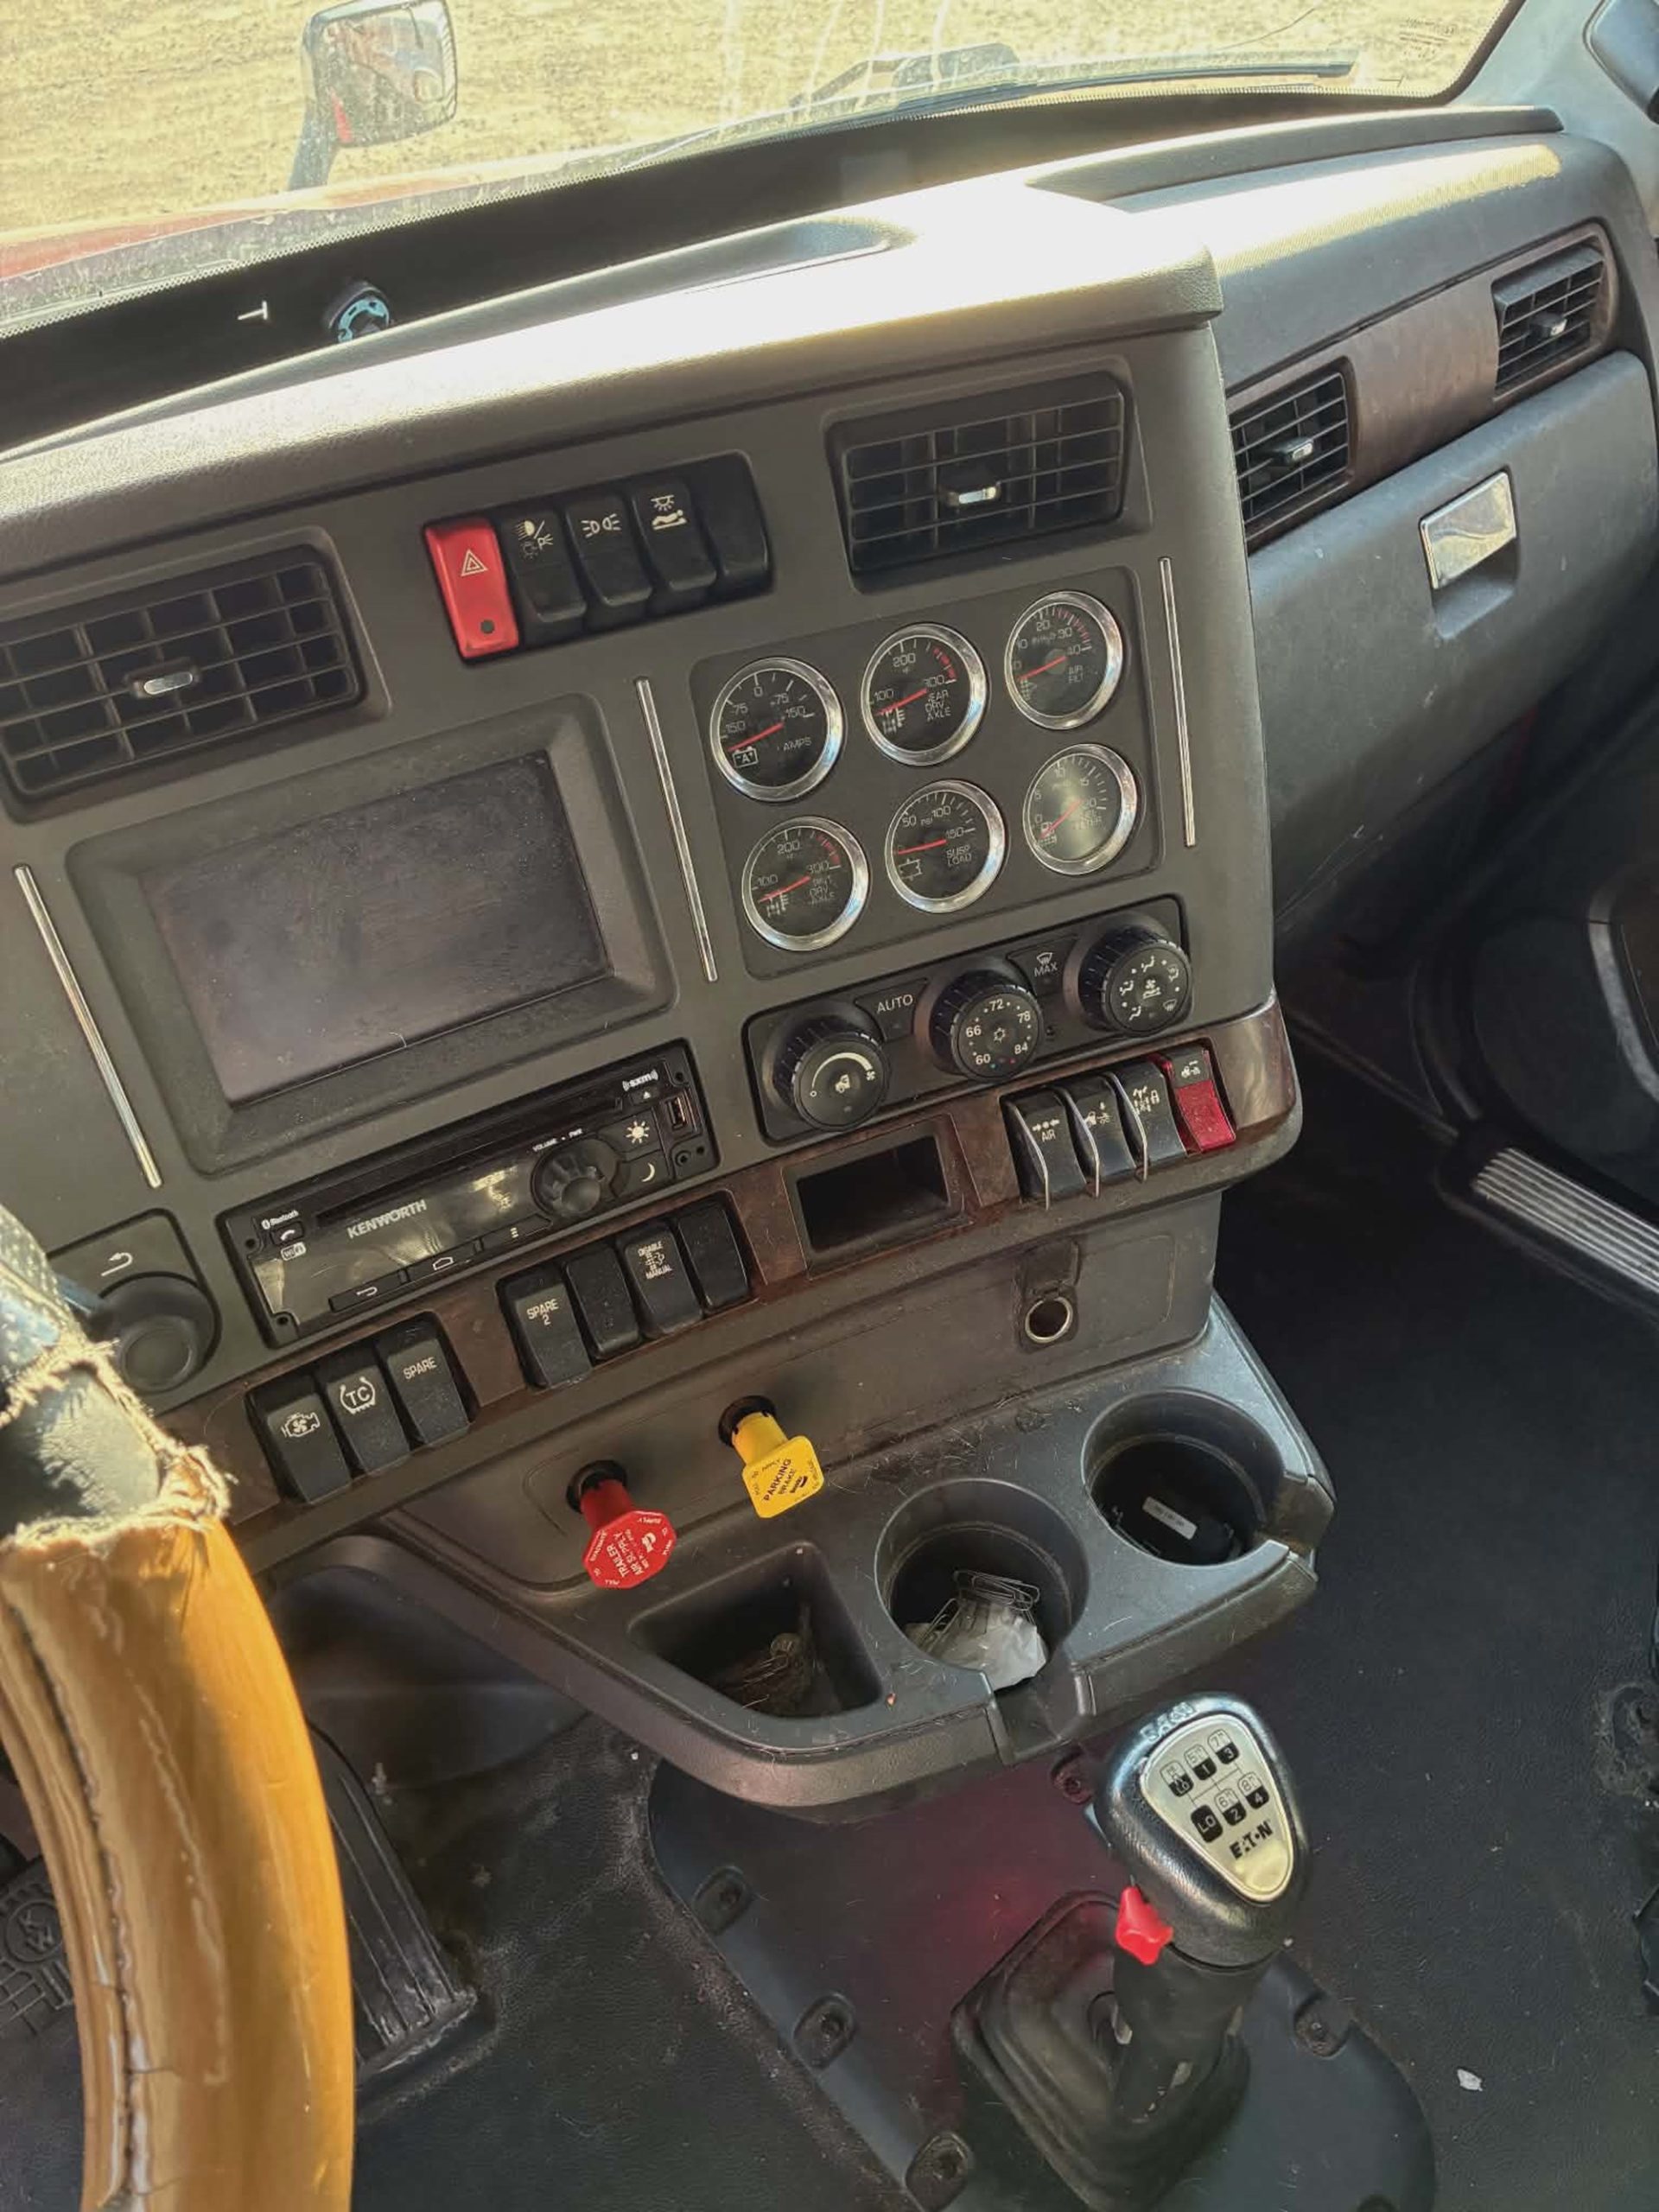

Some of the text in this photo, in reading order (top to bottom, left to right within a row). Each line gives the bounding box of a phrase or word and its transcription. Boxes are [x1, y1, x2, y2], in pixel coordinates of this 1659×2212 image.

[1037, 620, 1051, 632] 20
[1058, 627, 1072, 639] 30
[893, 652, 916, 667] 200
[753, 686, 763, 697] 0
[874, 688, 894, 701] 100
[927, 707, 951, 721] AXLE
[783, 737, 812, 751] AMPS
[931, 805, 951, 818] 100
[902, 816, 917, 827] 50
[945, 827, 964, 839] 150
[778, 840, 800, 855] 200
[808, 860, 830, 874] 300
[757, 874, 778, 887] 100
[1034, 962, 1058, 977] MAX
[876, 994, 913, 1014] AUTO
[989, 998, 1004, 1011] 72
[1017, 1010, 1032, 1024] 78
[965, 1025, 982, 1038] 66
[1014, 1042, 1029, 1055] 84
[976, 1053, 991, 1065] 60
[1041, 1129, 1056, 1142] AIR
[346, 1199, 428, 1239] KENWORTH
[527, 1299, 559, 1319] SPARE
[543, 1313, 551, 1325] 2
[403, 1357, 437, 1380] SPARE
[346, 1386, 370, 1406] TC
[764, 1459, 791, 1501] PARKING
[607, 1542, 630, 1578] TRAILER
[630, 1561, 645, 1575] AIR
[1224, 1747, 1235, 1759] 3
[1255, 1791, 1264, 1803] 4
[1230, 1808, 1242, 1821] 2
[1198, 1815, 1217, 1833] LO
